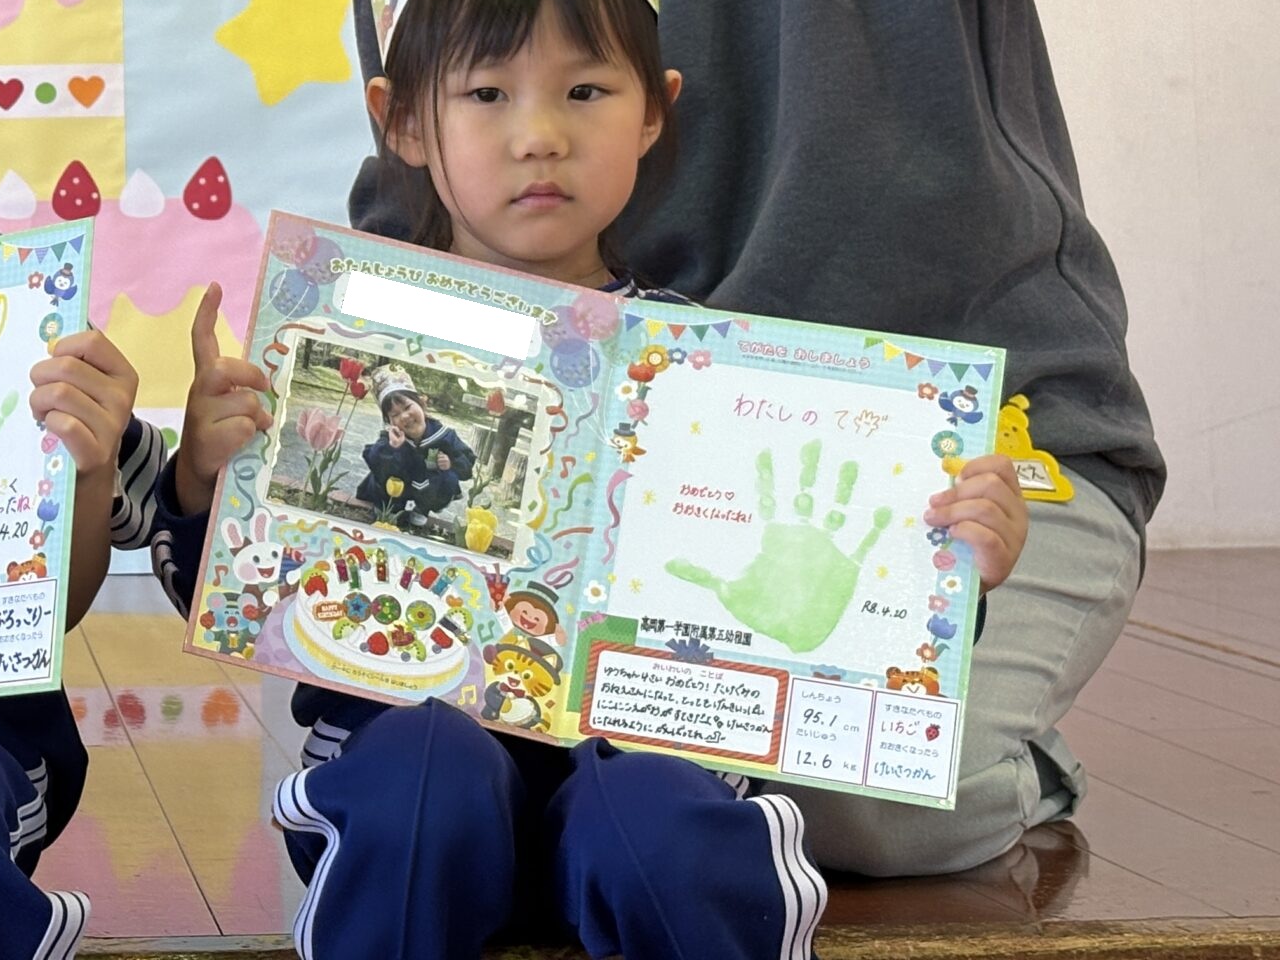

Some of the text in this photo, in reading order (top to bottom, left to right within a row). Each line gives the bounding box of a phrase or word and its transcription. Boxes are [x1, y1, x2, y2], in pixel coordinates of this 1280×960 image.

[330, 257, 558, 326] おたんじょうび おめでとうございます
[737, 340, 788, 358] てがたを
[793, 347, 870, 369] おしましょう
[803, 708, 837, 728] 95.1
[843, 723, 860, 732] cm
[881, 720, 920, 736] いちご
[796, 750, 833, 769] 12.6
